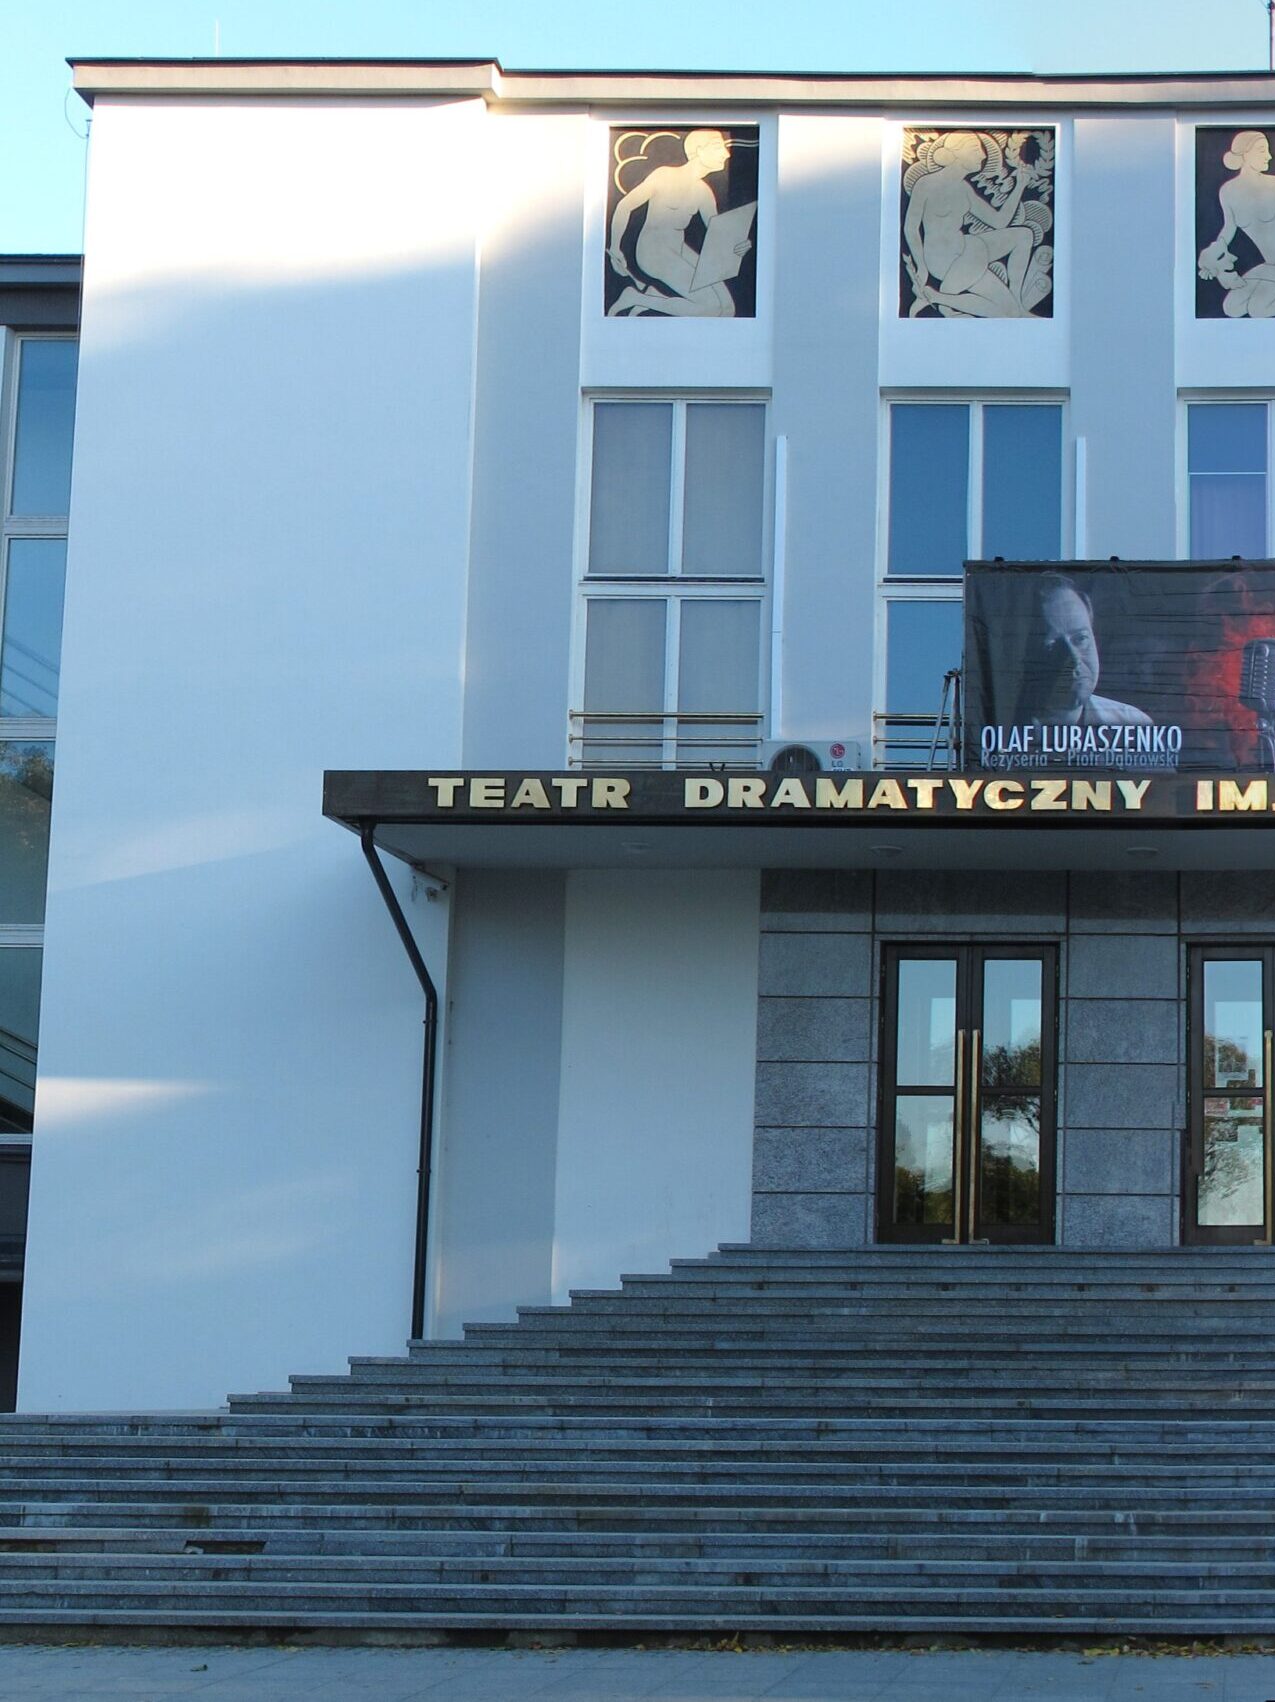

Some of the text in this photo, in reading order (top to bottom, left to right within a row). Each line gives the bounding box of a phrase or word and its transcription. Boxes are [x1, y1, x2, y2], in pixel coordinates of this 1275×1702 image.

[981, 725, 1183, 753] OLAF LUBASZENKO
[831, 760, 844, 768] LG
[981, 750, 1048, 771] Reżyseria
[1067, 749, 1100, 767] Piotr
[1105, 749, 1180, 770] Dąbrowski
[428, 777, 631, 809] TEATR
[684, 777, 1152, 810] DRAMATYCZNY
